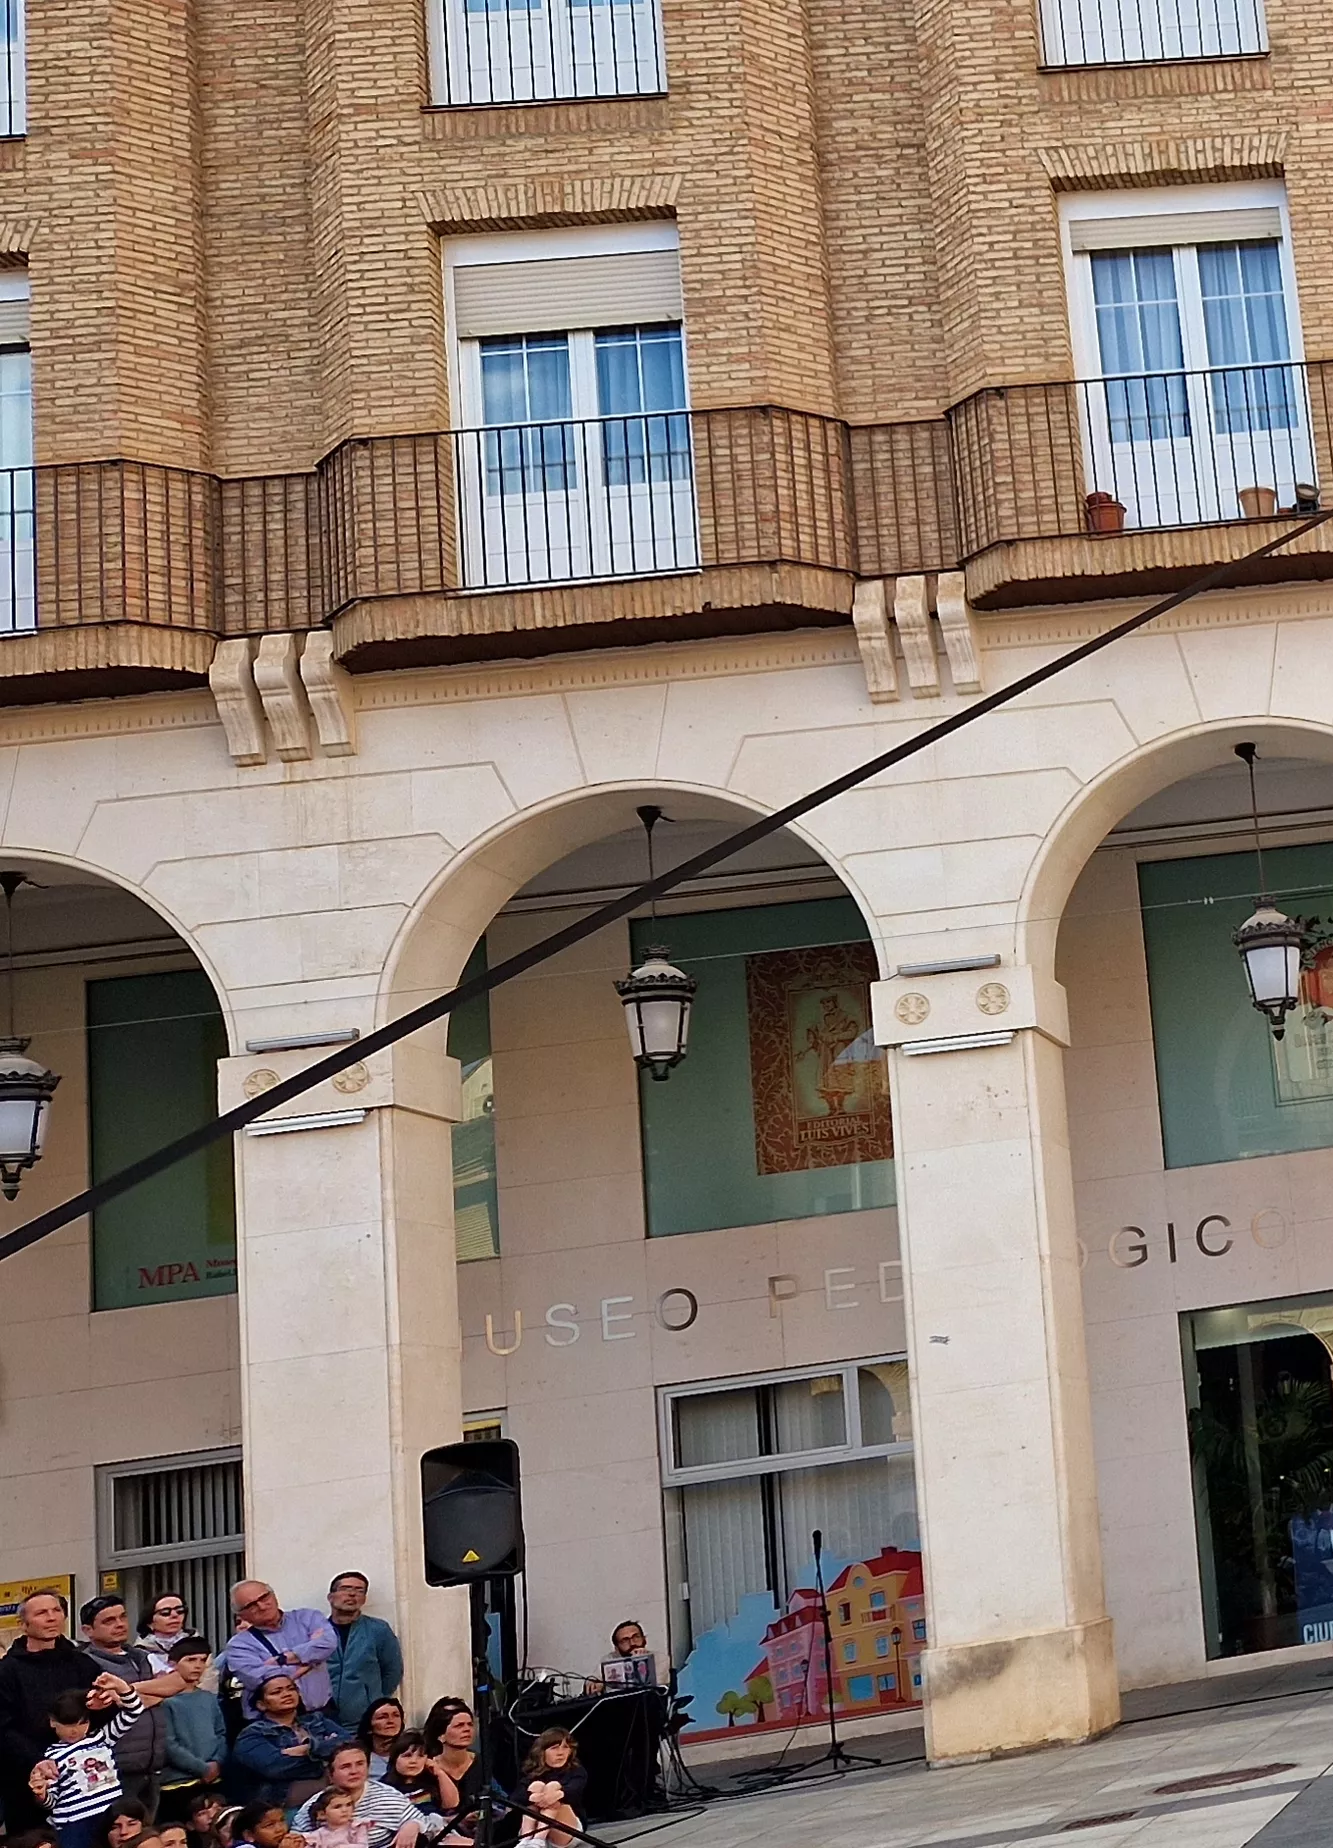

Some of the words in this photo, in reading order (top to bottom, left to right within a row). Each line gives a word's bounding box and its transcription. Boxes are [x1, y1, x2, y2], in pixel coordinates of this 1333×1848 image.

[800, 1127, 829, 1140] LUIS
[831, 1122, 869, 1137] VIVES
[807, 1116, 861, 1129] EDITORIAL
[138, 1262, 200, 1289] MPA
[459, 1287, 699, 1362] USEO
